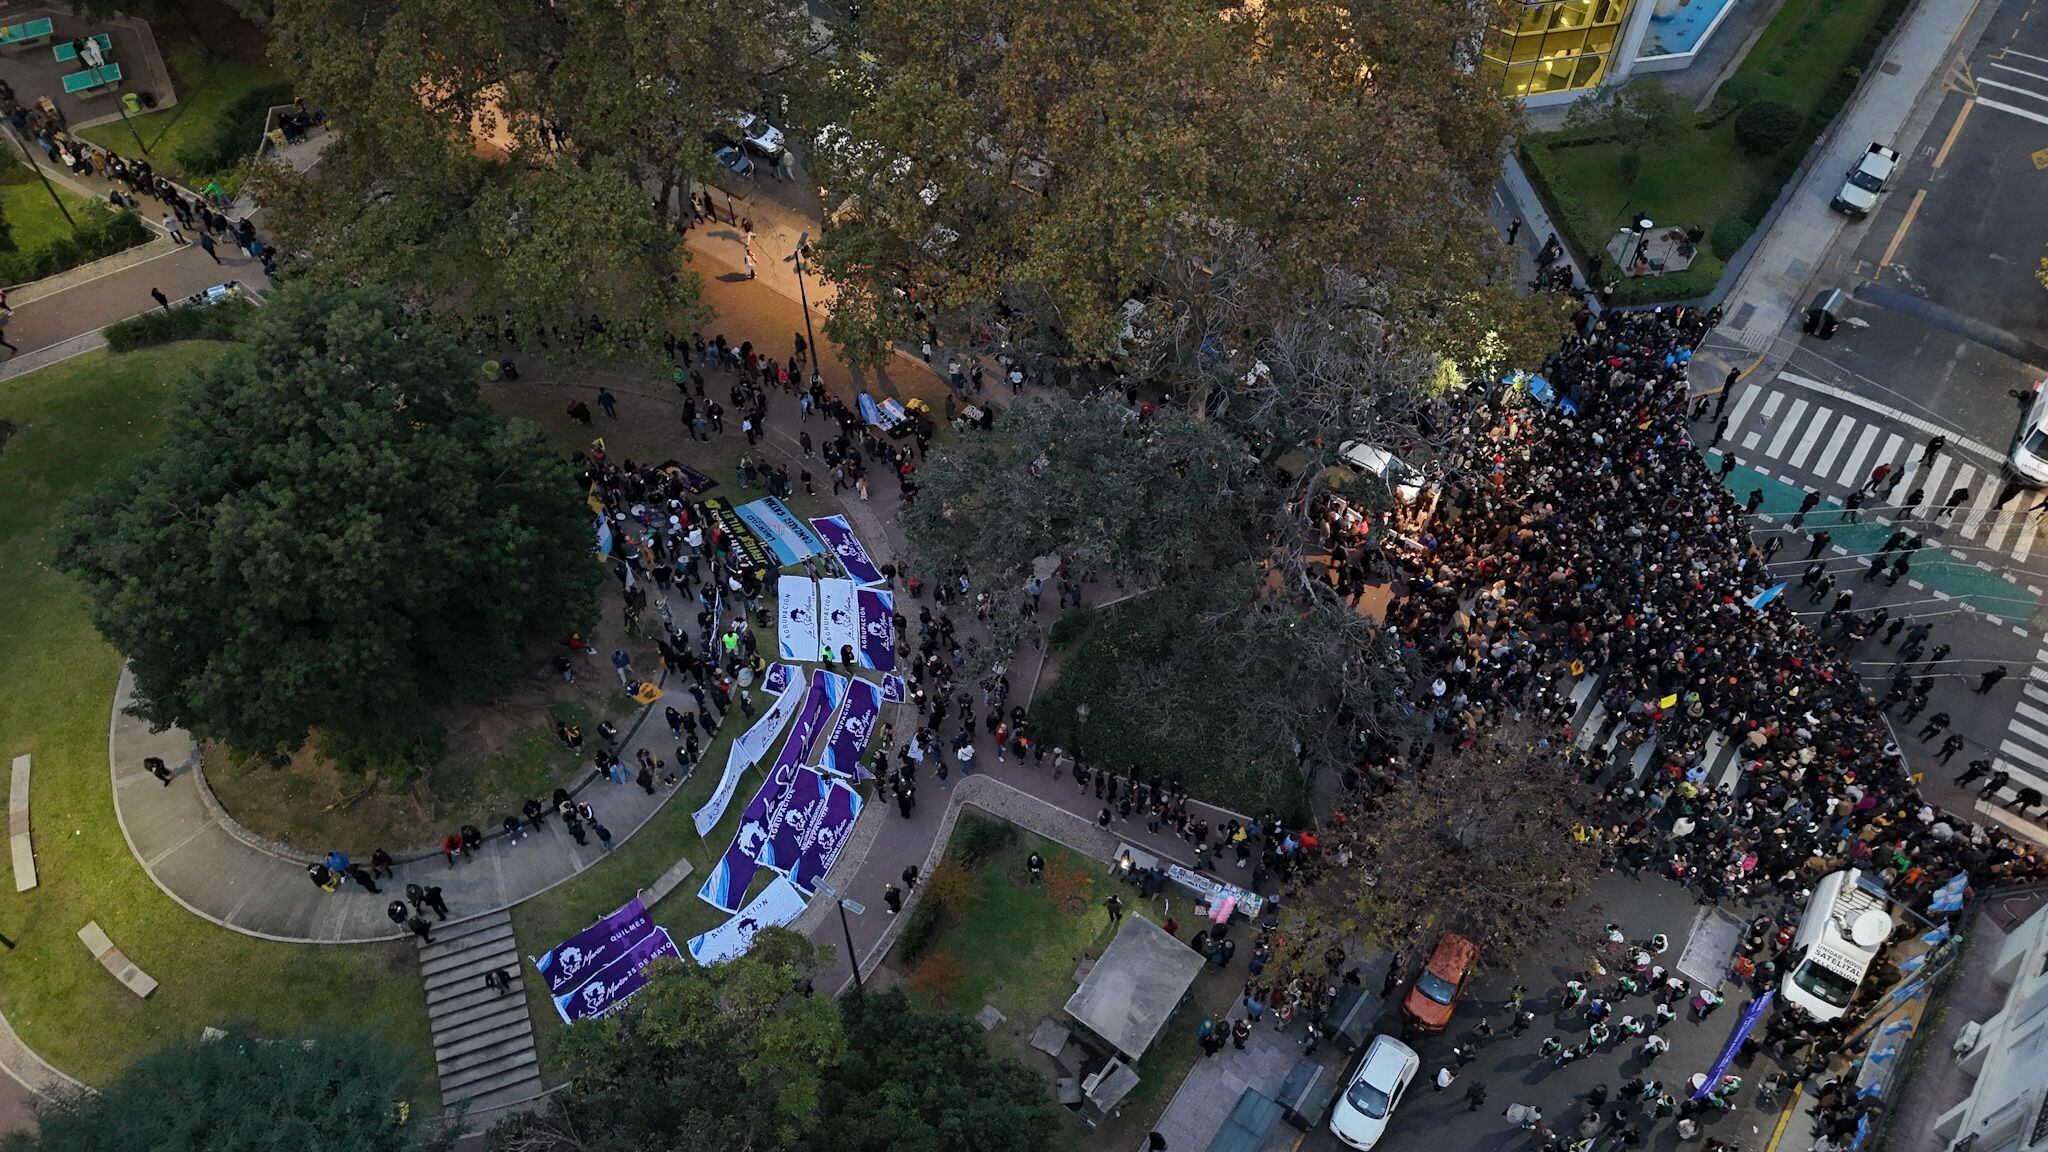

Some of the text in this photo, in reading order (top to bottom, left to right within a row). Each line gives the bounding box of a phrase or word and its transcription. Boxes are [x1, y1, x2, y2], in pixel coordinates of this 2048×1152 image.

[721, 510, 746, 534] MILEI
[610, 918, 646, 942] QUILMES
[626, 941, 672, 978] 25 DE MAYO
[1814, 949, 1860, 977] SATELITAL
[1818, 944, 1842, 960] UNIDAD
